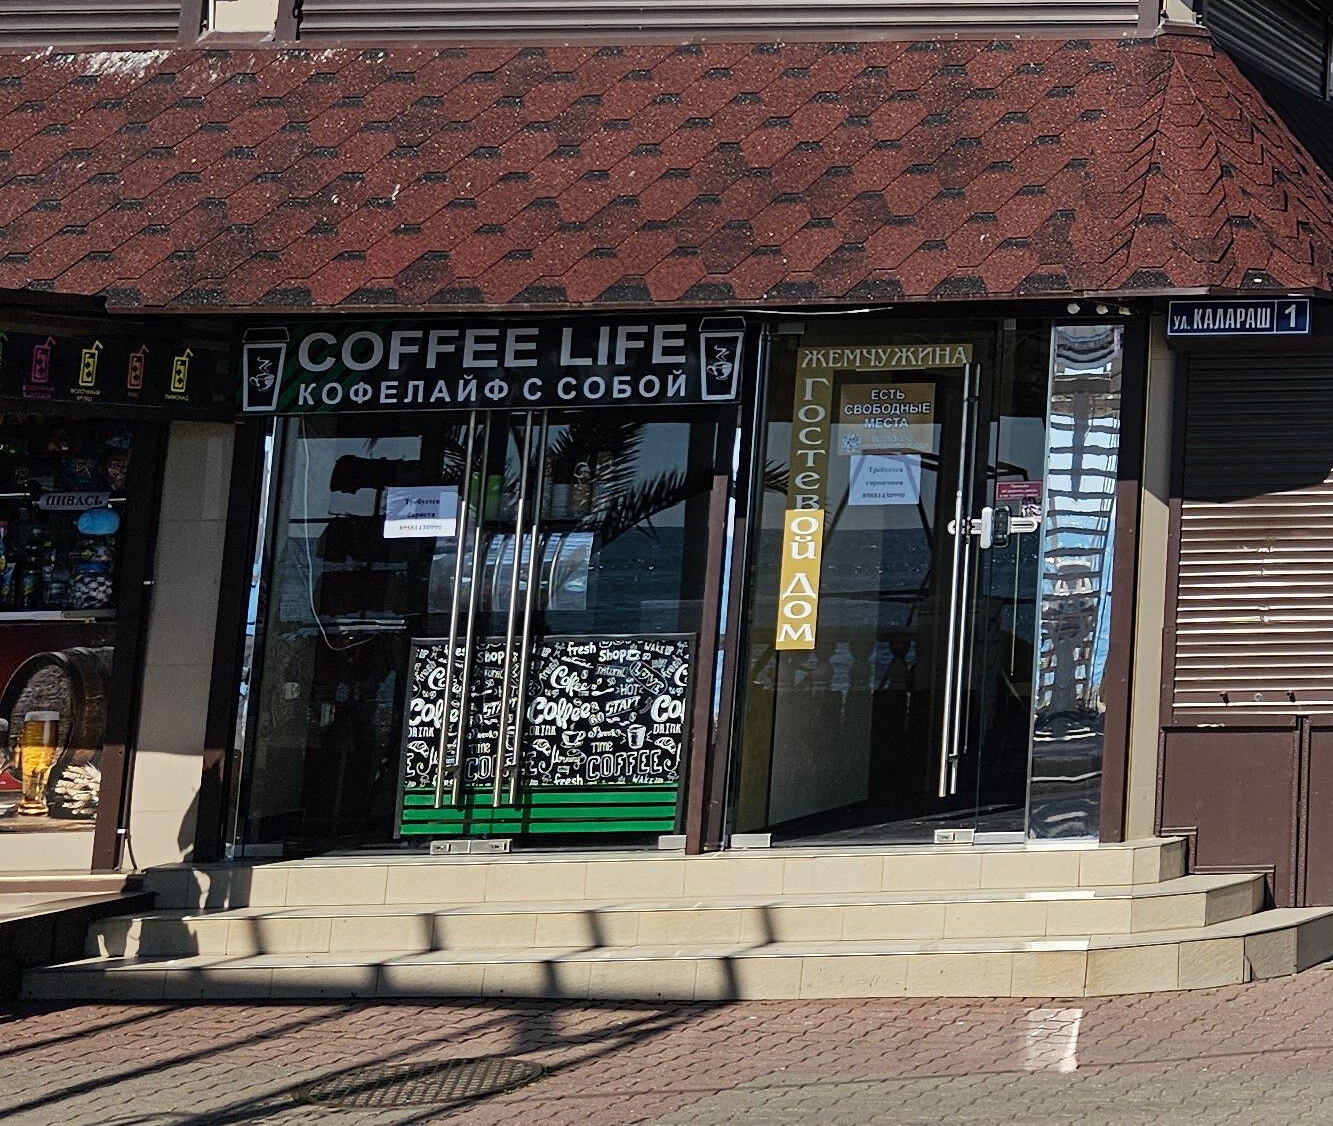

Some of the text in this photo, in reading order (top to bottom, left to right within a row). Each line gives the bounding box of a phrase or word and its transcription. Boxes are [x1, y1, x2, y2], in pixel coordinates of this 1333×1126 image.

[1173, 304, 1297, 330] ул. КАЛАРАШ 1
[298, 324, 687, 371] COFFEE LIFE
[801, 346, 968, 368] ЖЕМЧУЖИНА
[298, 370, 687, 405] КОФЕЛАЙФ С СОБОЙ
[871, 389, 905, 400] ЕСТЬ
[844, 403, 931, 415] СВОБОДНЫЕ
[864, 418, 909, 429] МЕСТА
[527, 696, 591, 729] Coffee
[586, 749, 663, 781] COFFEE
